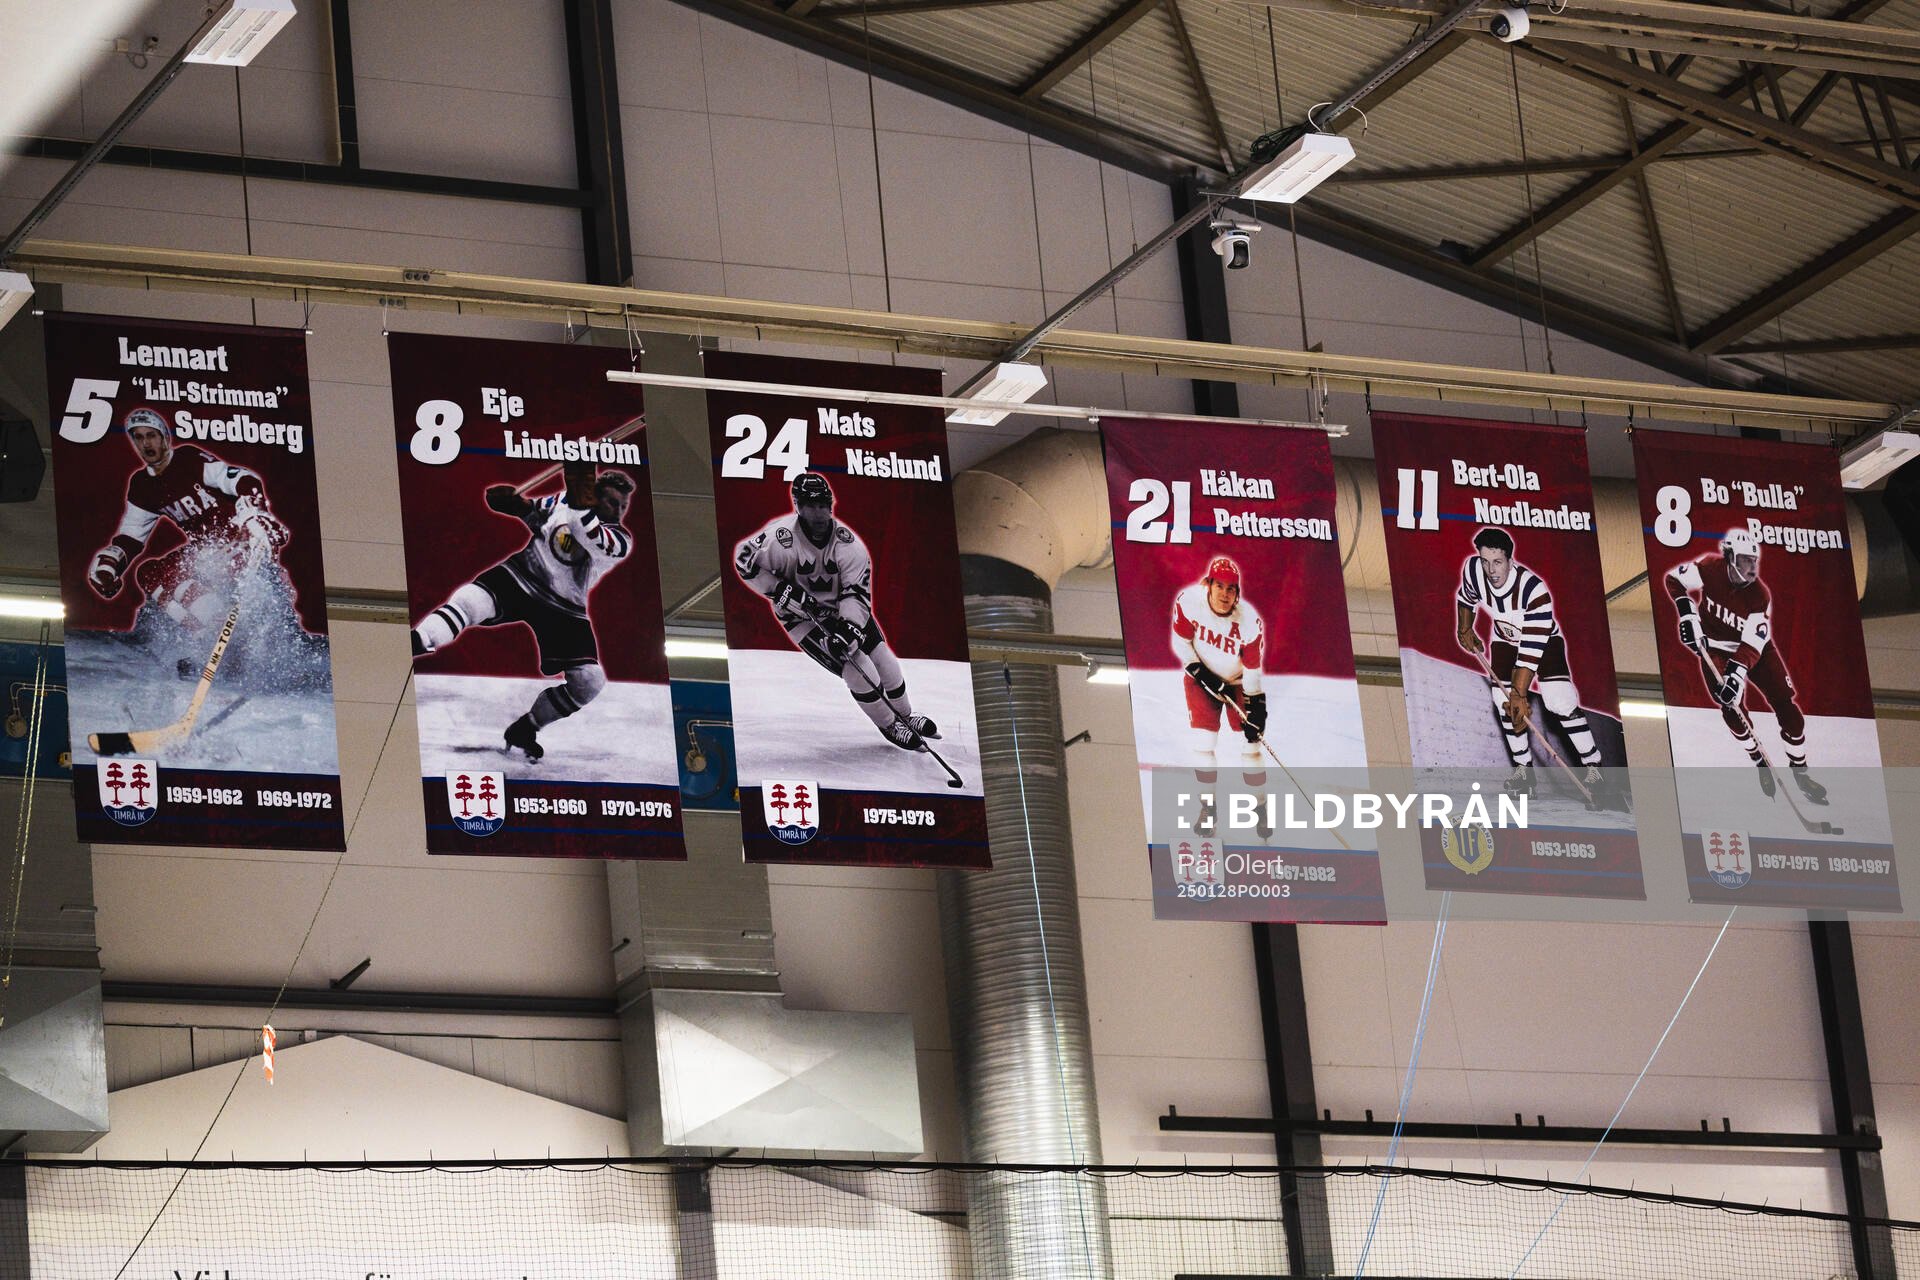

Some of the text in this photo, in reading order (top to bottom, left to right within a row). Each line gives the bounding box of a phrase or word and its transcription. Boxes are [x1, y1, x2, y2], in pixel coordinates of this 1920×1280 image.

[118, 337, 228, 371] Lennart
[59, 378, 120, 443] 5
[481, 387, 524, 423] Eje
[174, 410, 304, 453] Svedberg
[410, 400, 464, 465] 8
[817, 408, 876, 438] Mats
[504, 430, 641, 465] Lindström
[721, 414, 809, 482] 24
[846, 448, 943, 482] Näslund
[1452, 459, 1541, 491] Bert-Ola
[1200, 469, 1275, 500] Håkan
[1397, 468, 1439, 531] 11
[1700, 478, 1730, 505] Bo
[1126, 478, 1192, 544] 21
[1213, 508, 1332, 541] Pettersson
[1473, 497, 1591, 531] Nordlander
[1654, 485, 1692, 547] 8
[1746, 517, 1843, 554] Berggren
[166, 786, 332, 809] 1959-1962 1969-1972
[513, 797, 672, 818] 1953-1960 1970-1976
[114, 809, 145, 821] TIMRÅ IK
[463, 819, 494, 831] TIMRÅ IK
[863, 808, 936, 826] 1975-1978
[778, 827, 808, 840] TIMRÅ IK
[1531, 841, 1596, 859] 1953-1963
[1717, 874, 1736, 884] TIMRÅ
[1757, 853, 1890, 875] 1967-1975 1980-1987
